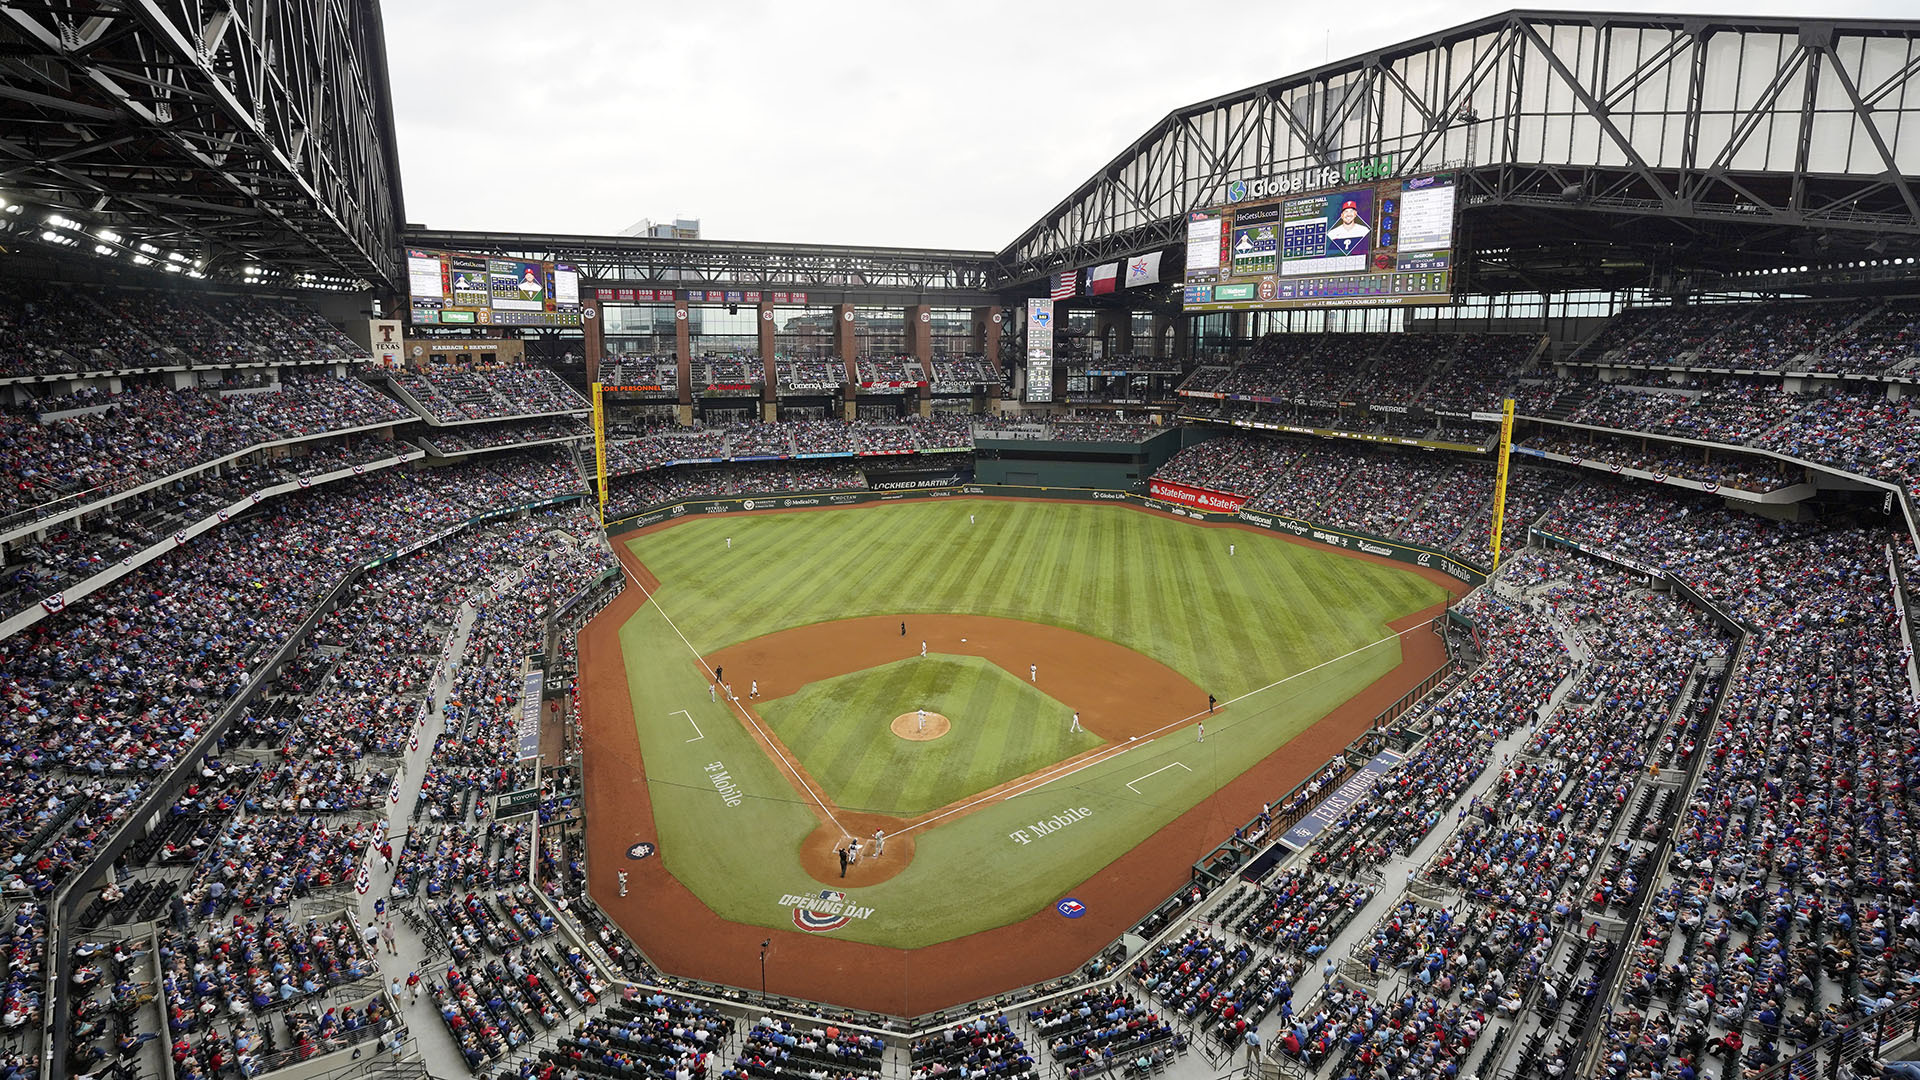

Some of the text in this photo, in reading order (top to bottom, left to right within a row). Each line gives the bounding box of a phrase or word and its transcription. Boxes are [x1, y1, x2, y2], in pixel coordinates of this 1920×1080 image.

[1252, 154, 1392, 197] Globe Life Field
[1237, 210, 1278, 221] HeGetsUs.com
[585, 309, 594, 317] 42
[379, 325, 394, 341] T
[1370, 405, 1408, 413] POWERADE
[875, 481, 916, 490] LOCKHEED
[1247, 514, 1272, 525] National
[1287, 521, 1308, 535] Kroger
[1314, 531, 1324, 539] BIG
[1448, 563, 1470, 582] Mobile
[522, 690, 539, 738] TEXAS RANGERS
[512, 792, 538, 801] TOYOTA
[710, 770, 742, 808] Mobile
[1312, 768, 1380, 822] TEXAS RANGERS
[1032, 806, 1092, 840] Mobile
[778, 894, 875, 919] OPENING DAY
